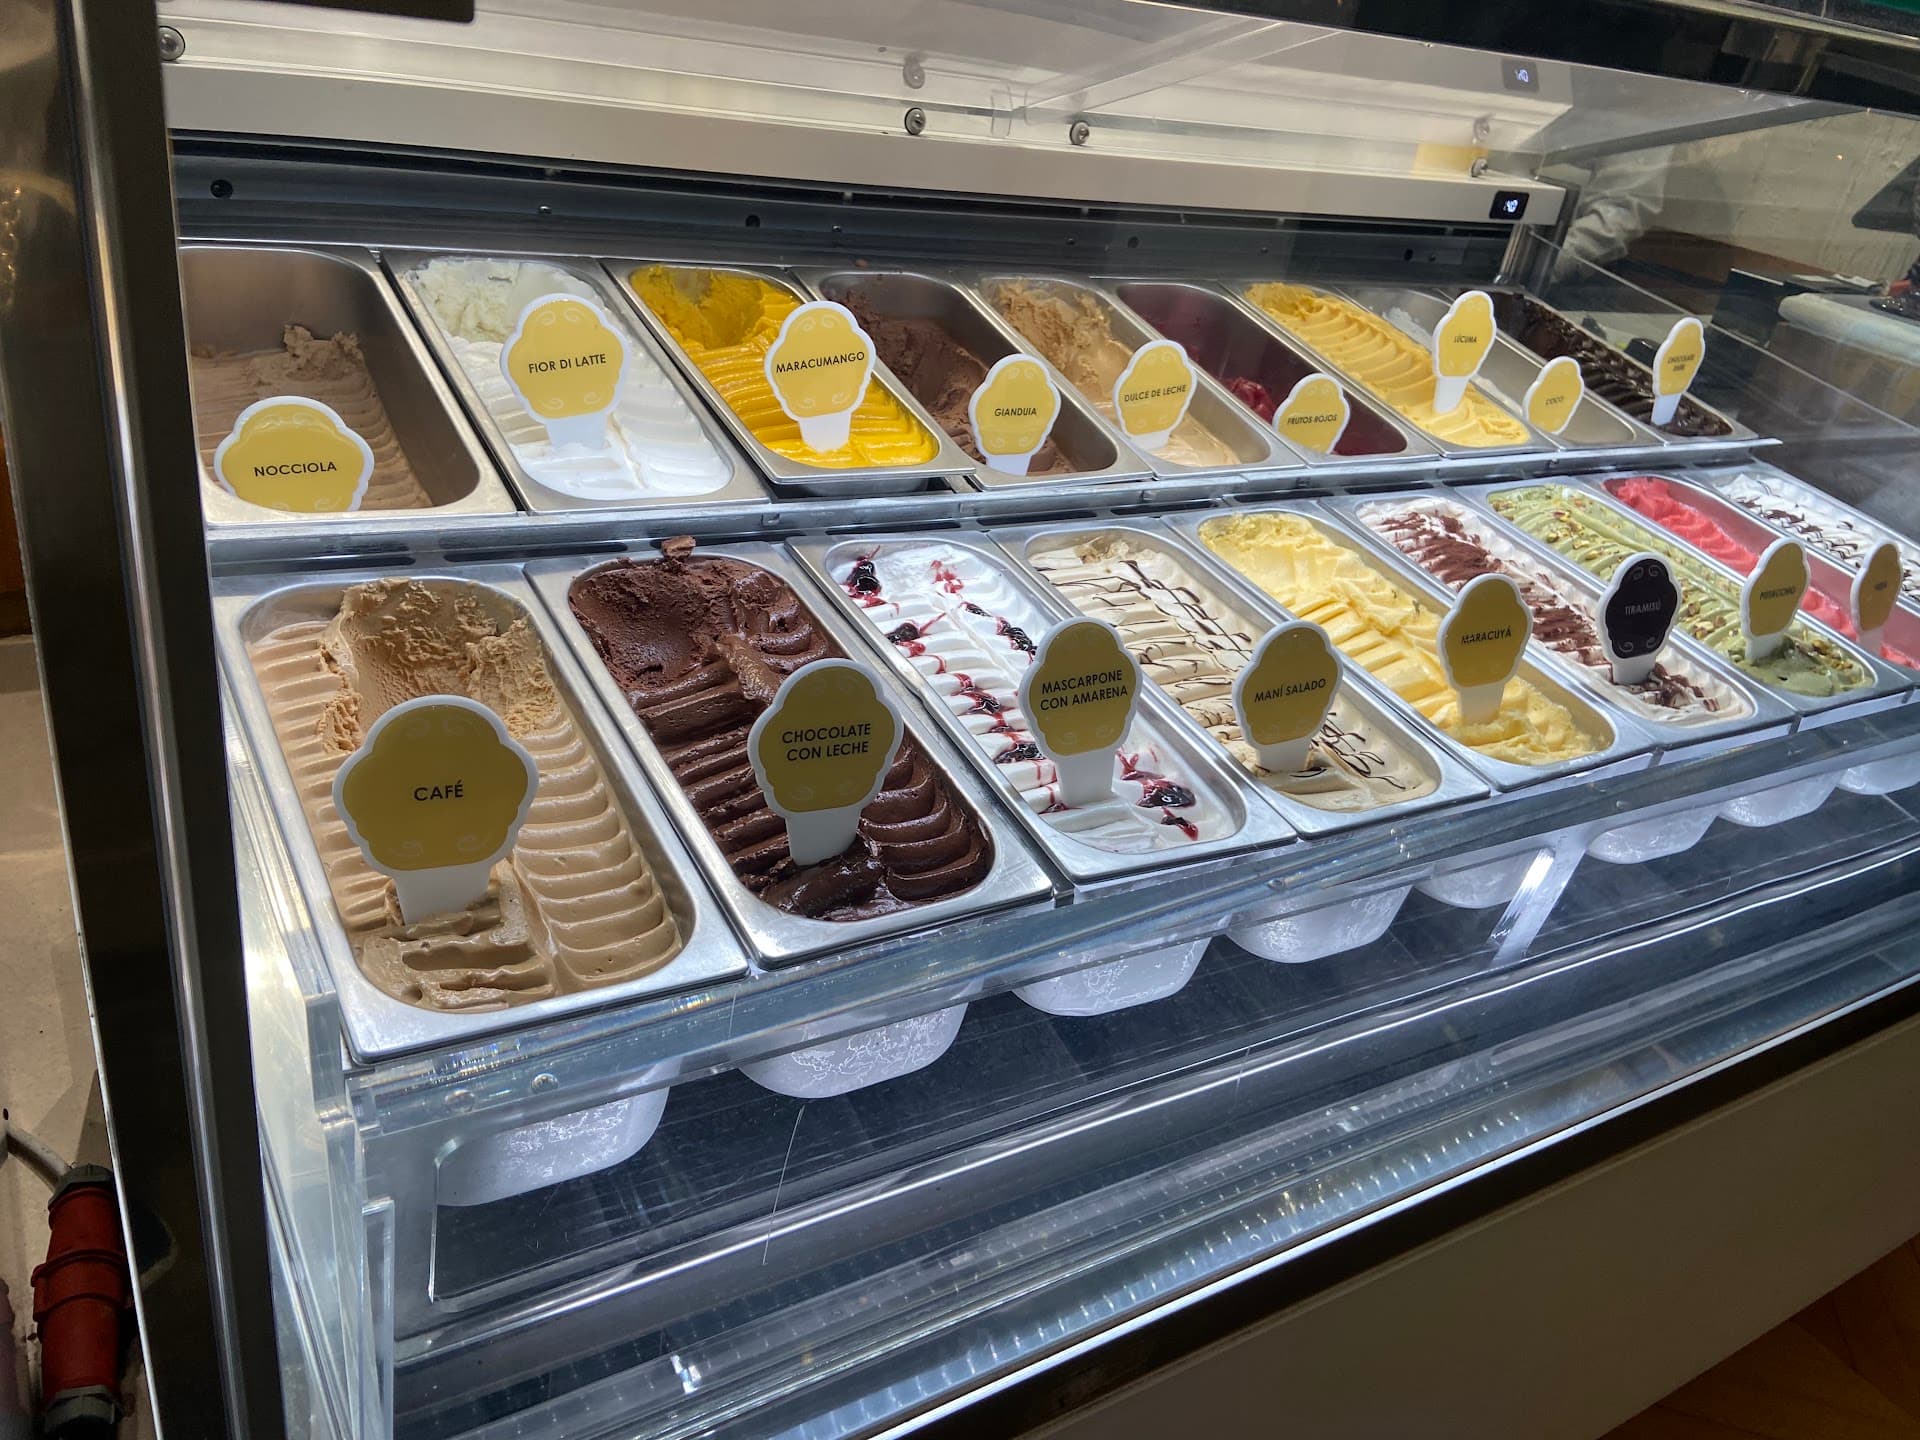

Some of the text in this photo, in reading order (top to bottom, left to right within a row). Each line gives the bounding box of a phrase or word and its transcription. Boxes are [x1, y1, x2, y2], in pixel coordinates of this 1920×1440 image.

[528, 353, 607, 374] FIOR DI LATTE
[775, 351, 865, 374] MARACUMANGO
[1124, 384, 1187, 402] DULCE DE LECHE
[994, 407, 1037, 417] GIANDUIA
[1287, 414, 1338, 425] FRUTOS ROJOS
[253, 461, 337, 477] NOCCIOLA
[1461, 625, 1512, 646] MARACUYÁ
[1042, 669, 1123, 695] MASCARPONE
[1254, 678, 1327, 703] MANÍ SALADO
[1040, 685, 1129, 711] CON AMARENA
[782, 723, 872, 744] CHOCOLATE
[786, 741, 869, 762] CON LECHE
[413, 779, 464, 802] CAFÉ
